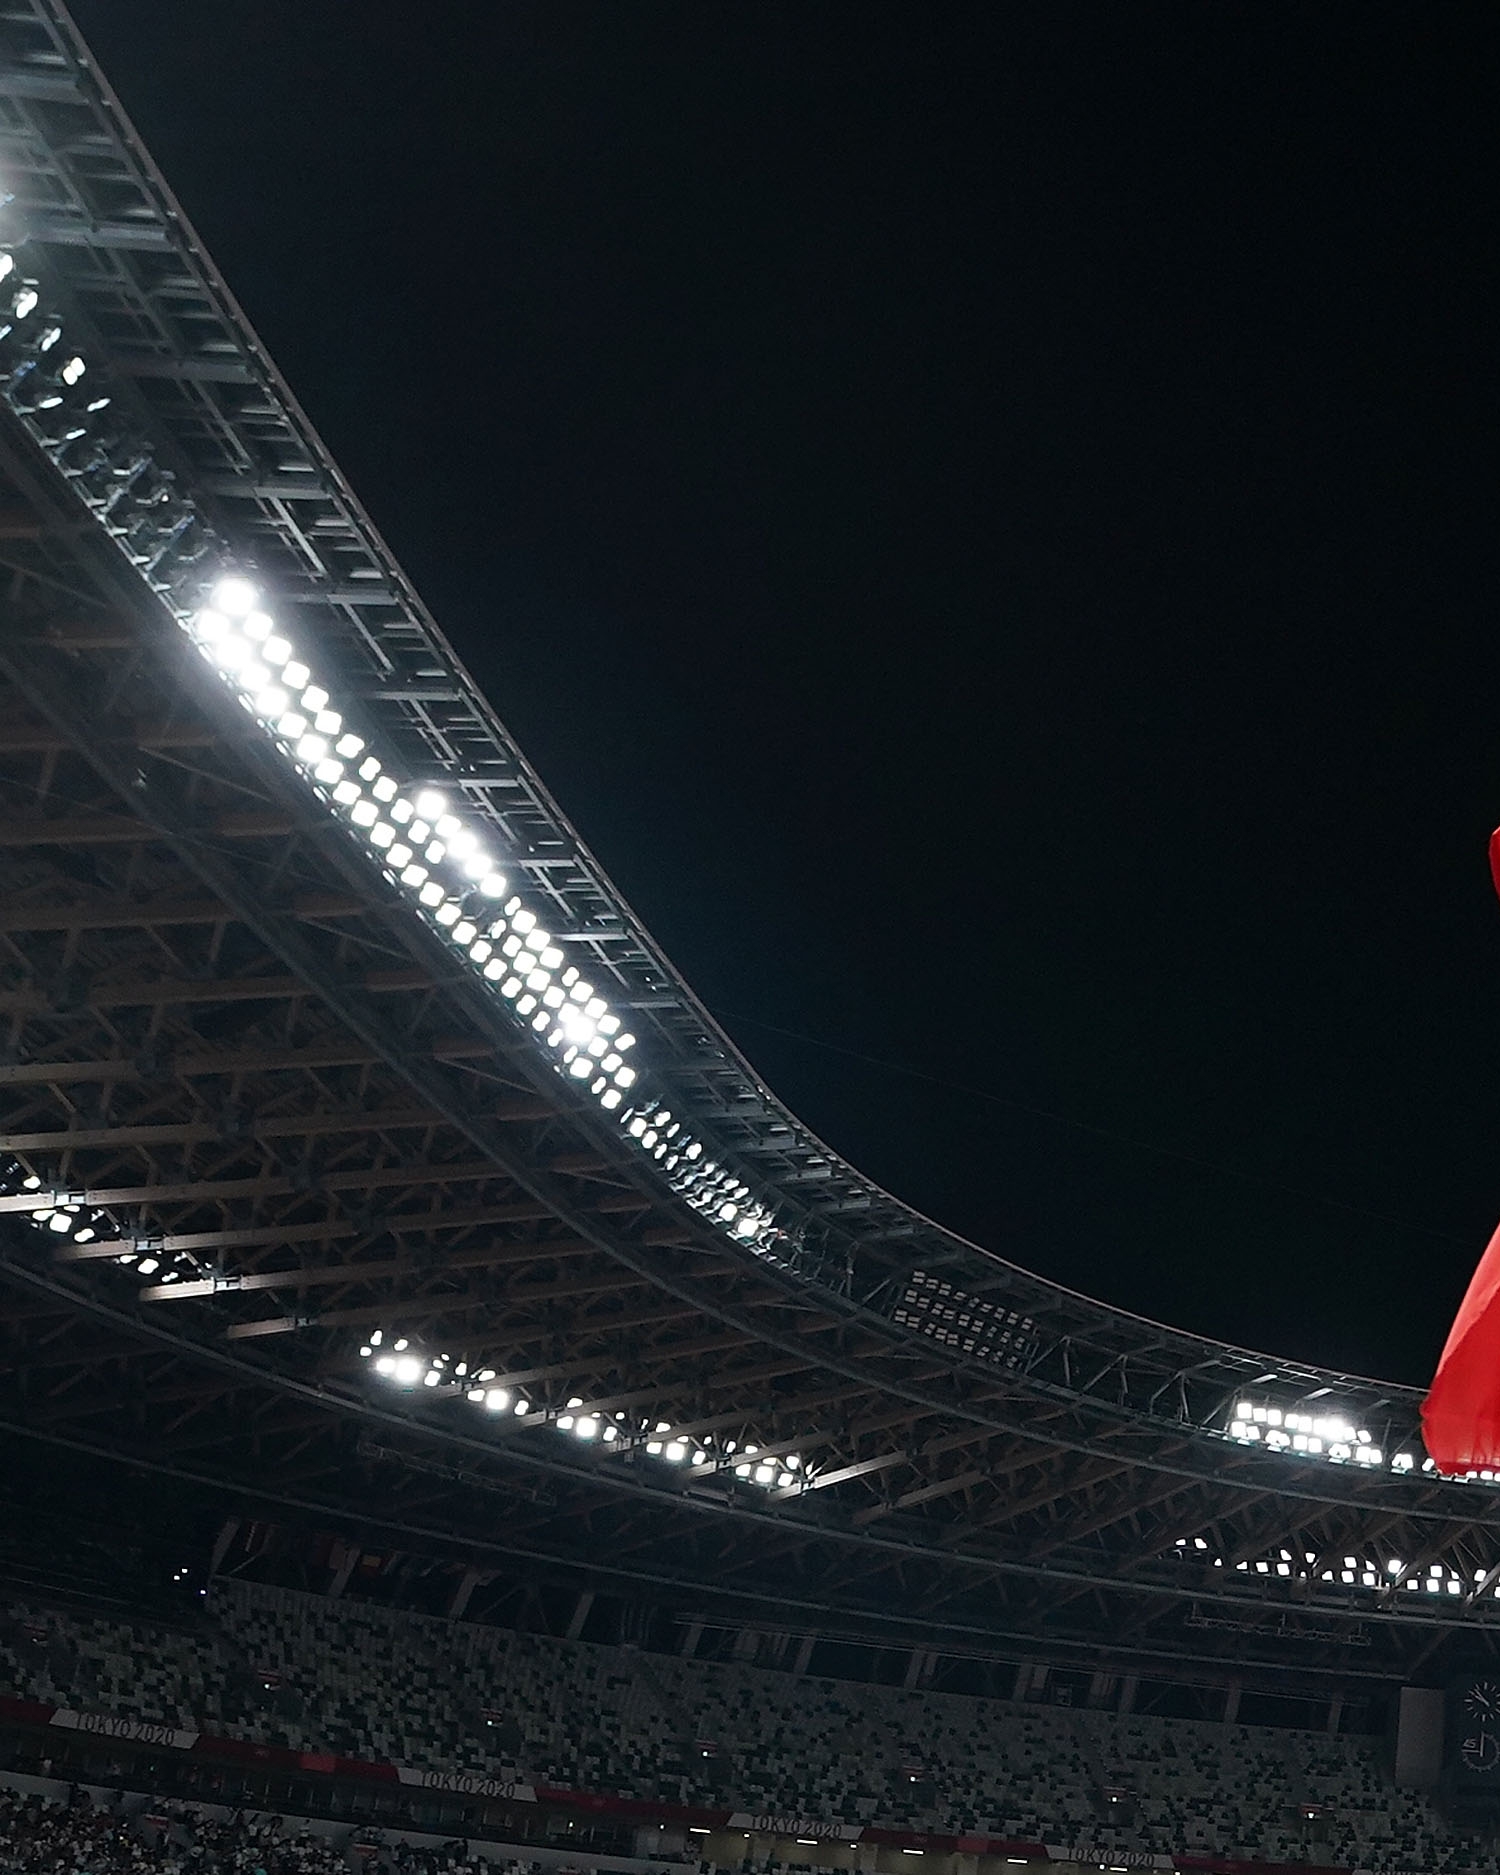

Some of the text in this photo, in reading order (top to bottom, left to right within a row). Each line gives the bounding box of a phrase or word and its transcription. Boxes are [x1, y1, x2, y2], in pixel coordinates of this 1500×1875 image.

[76, 1711, 176, 1746] TOKYO 2020
[420, 1771, 516, 1799] TOKYO 2020
[750, 1813, 842, 1840] TOKYO 2020
[1067, 1846, 1155, 1868] TOKYO 2020
